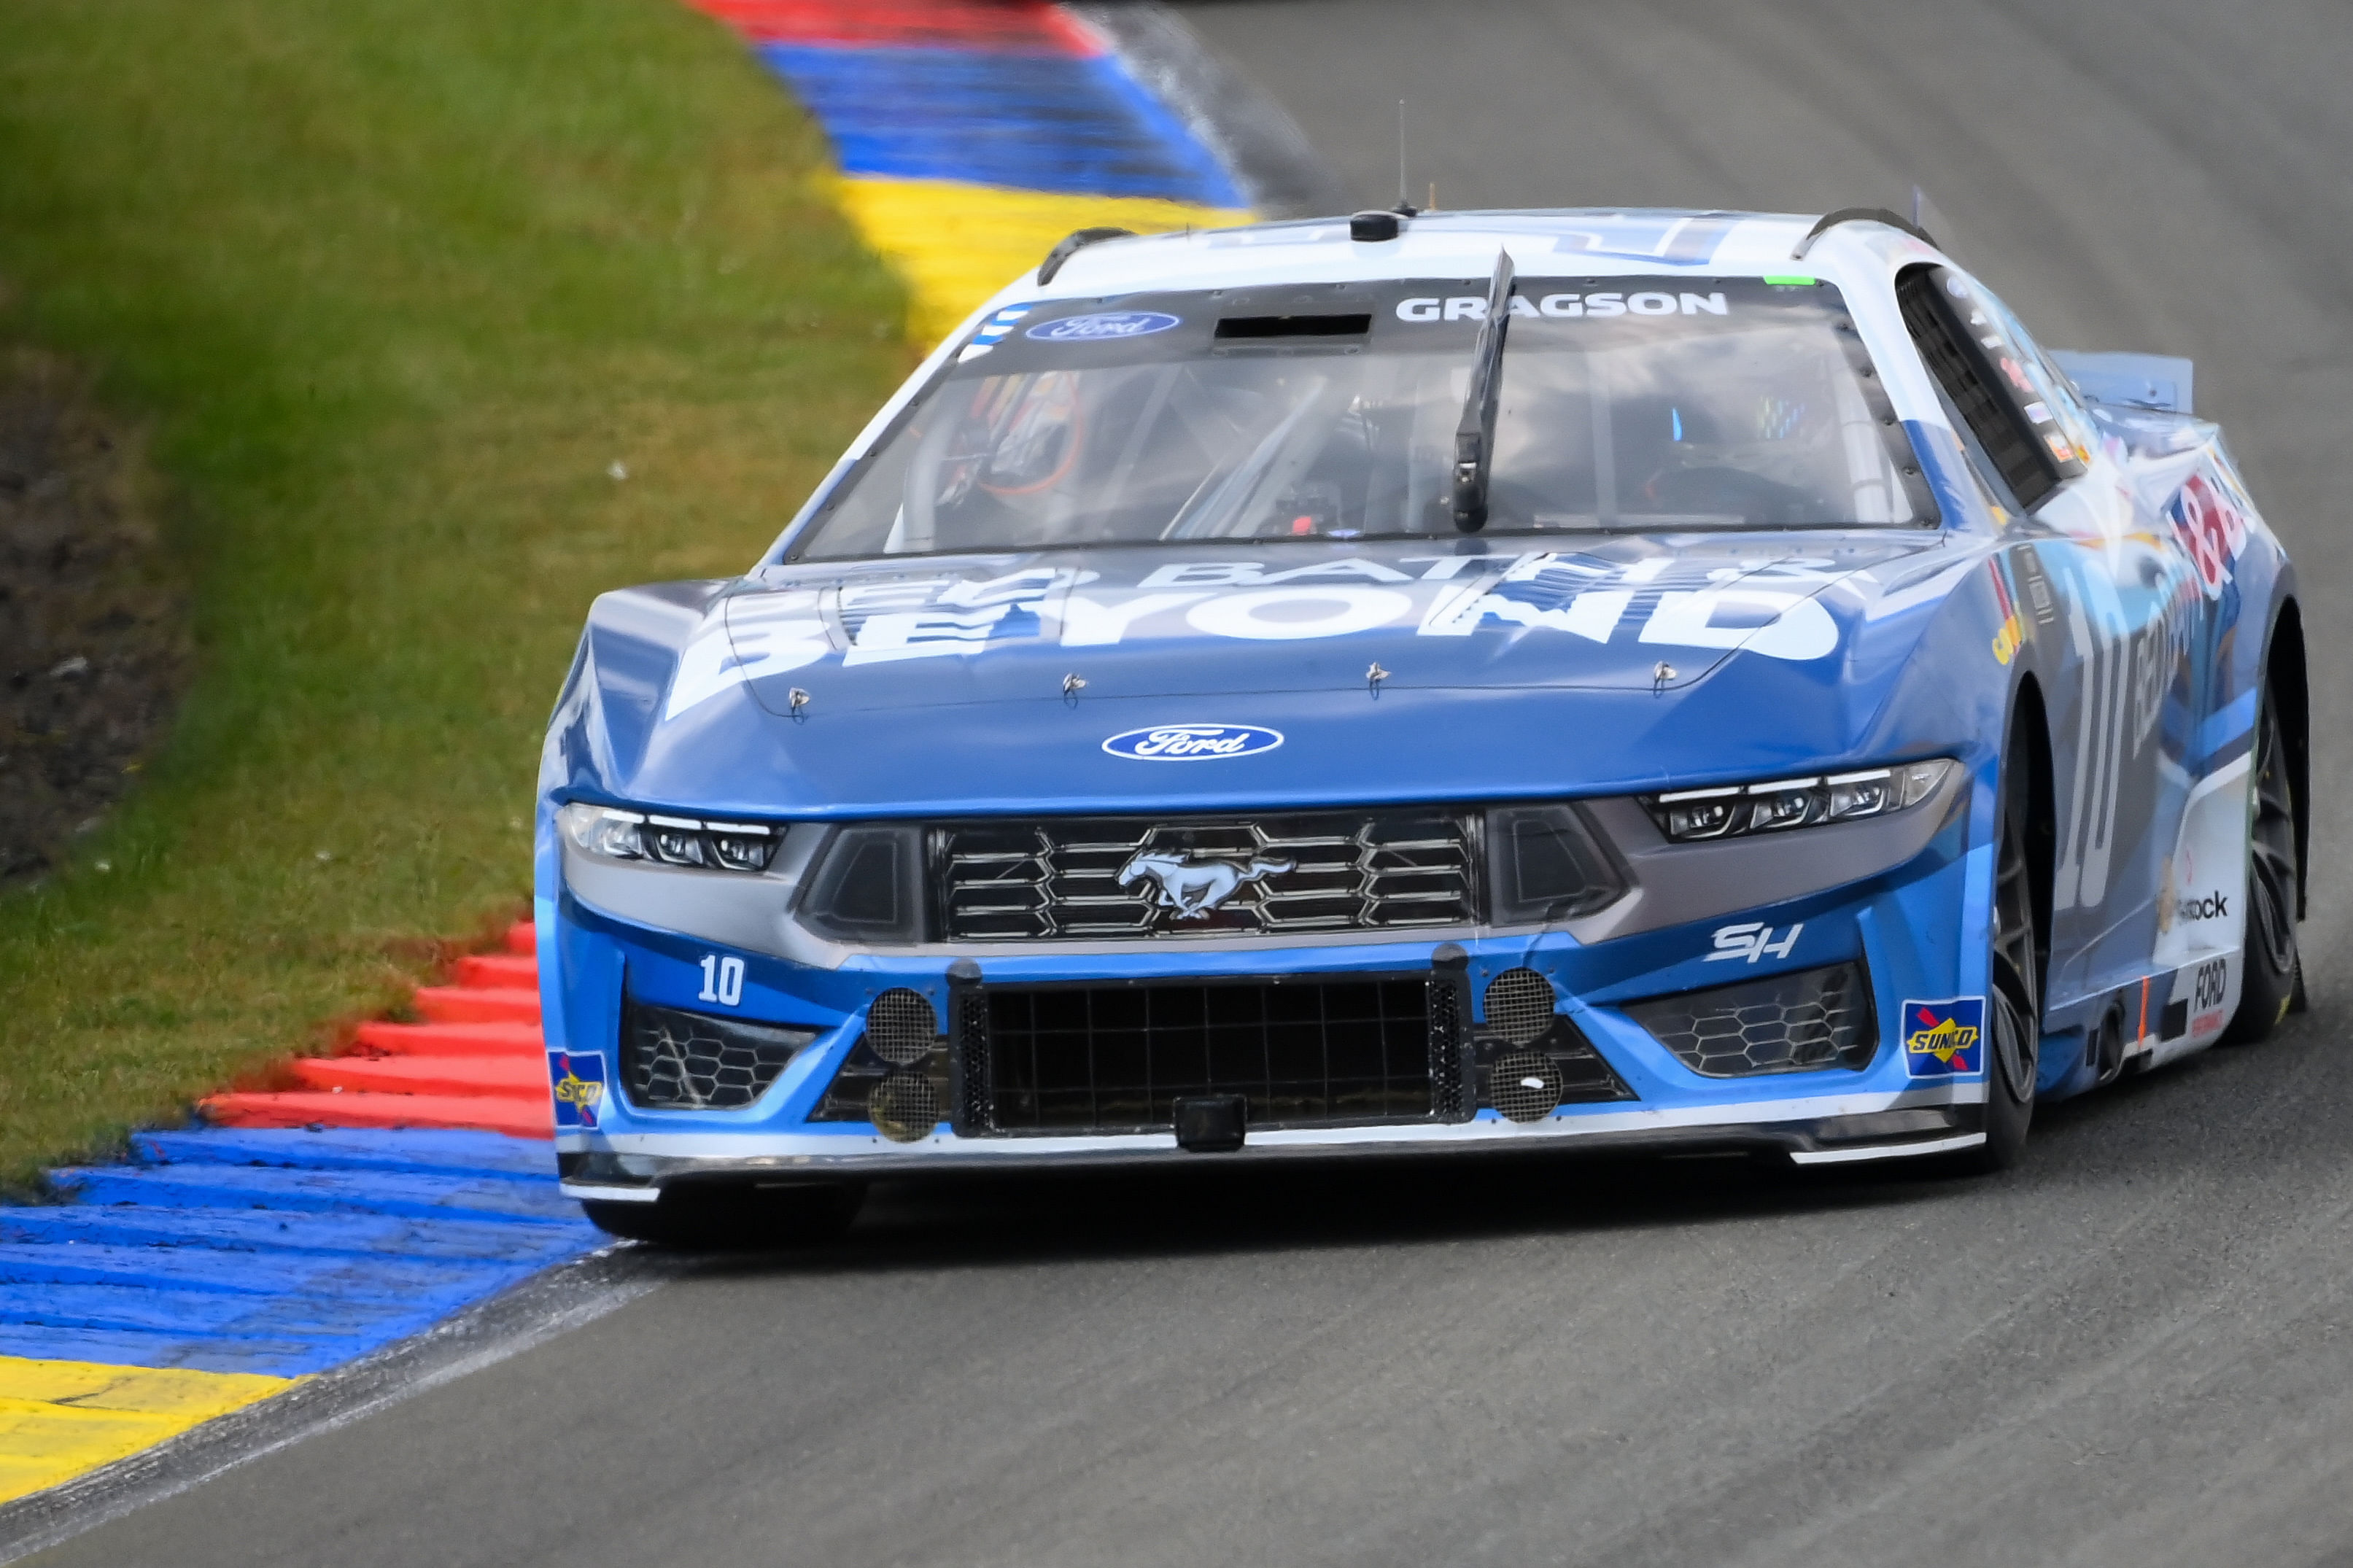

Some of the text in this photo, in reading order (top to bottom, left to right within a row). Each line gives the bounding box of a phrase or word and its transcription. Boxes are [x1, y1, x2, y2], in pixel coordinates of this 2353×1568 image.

[1050, 314, 1151, 337] Ford
[1396, 292, 1729, 323] GRAGSON
[665, 585, 1840, 722] BEYOND
[1134, 728, 1250, 756] Ford
[698, 954, 745, 1006] 10
[2193, 958, 2227, 1013] FORD
